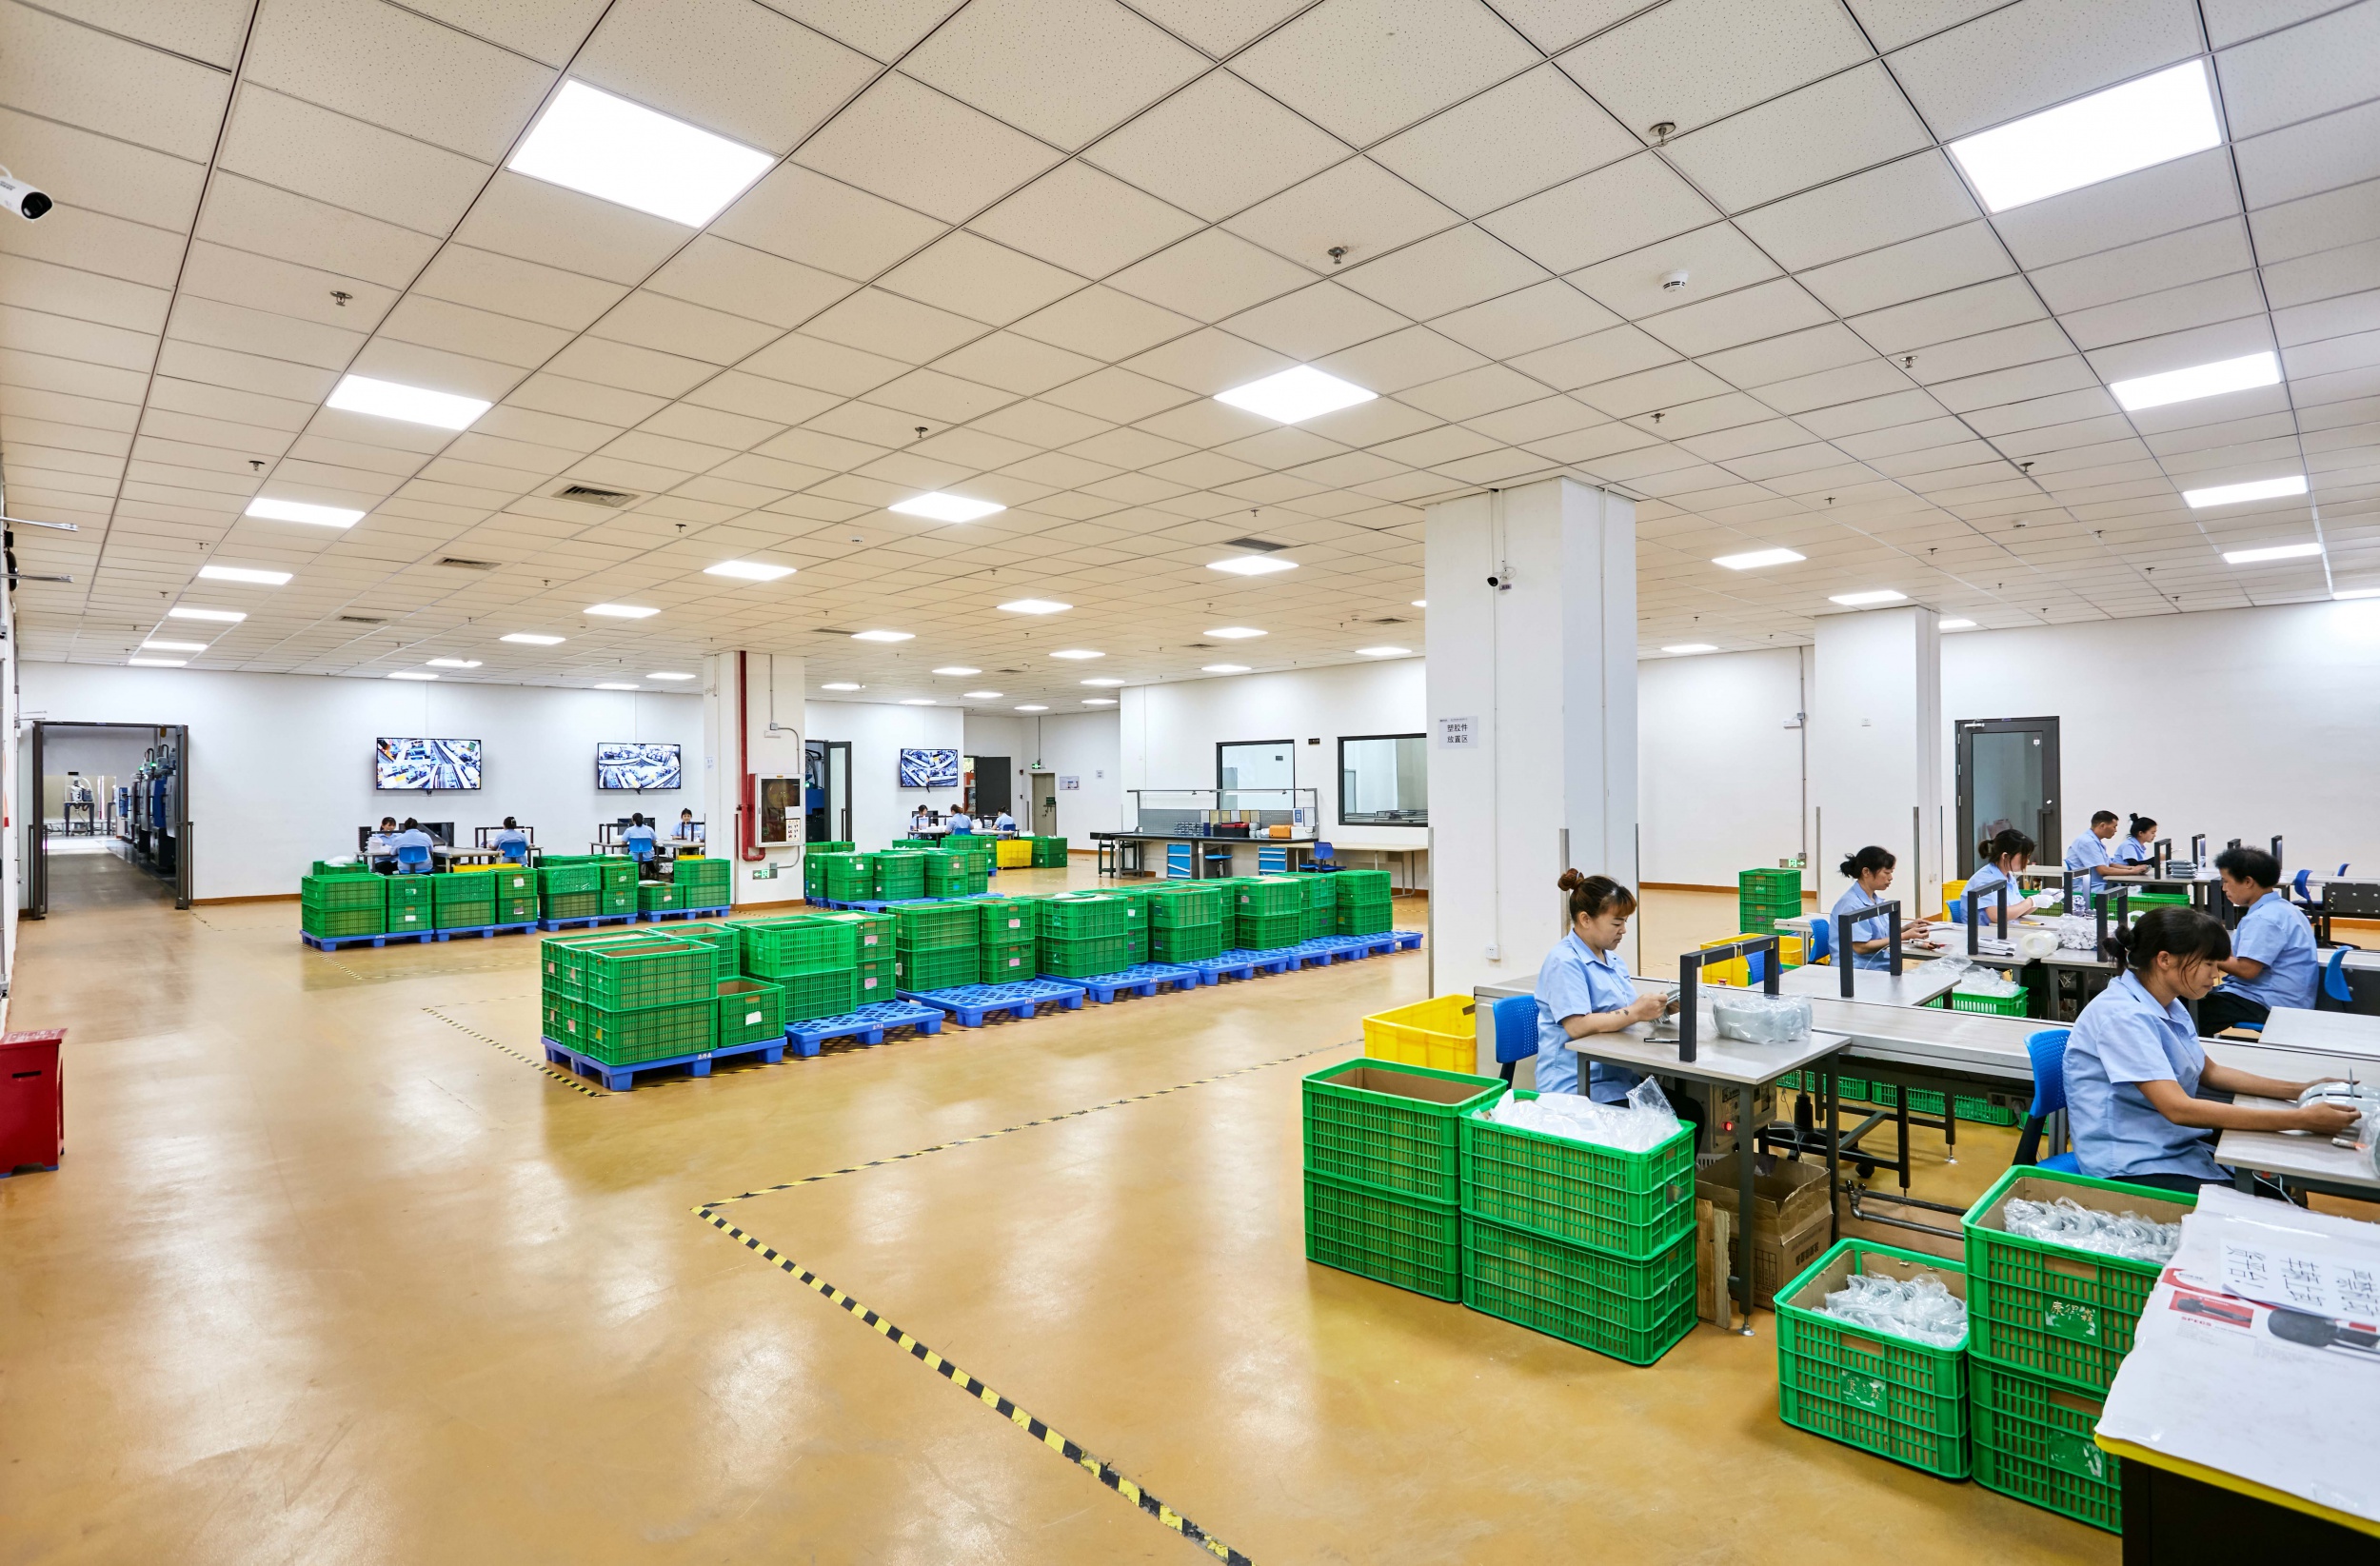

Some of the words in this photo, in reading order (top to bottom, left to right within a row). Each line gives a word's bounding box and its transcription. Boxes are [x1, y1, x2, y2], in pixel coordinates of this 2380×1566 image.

[1447, 724, 1468, 732] 塑胶件
[1447, 734, 1468, 743] 放置区
[2181, 1316, 2211, 1327] SPECS
